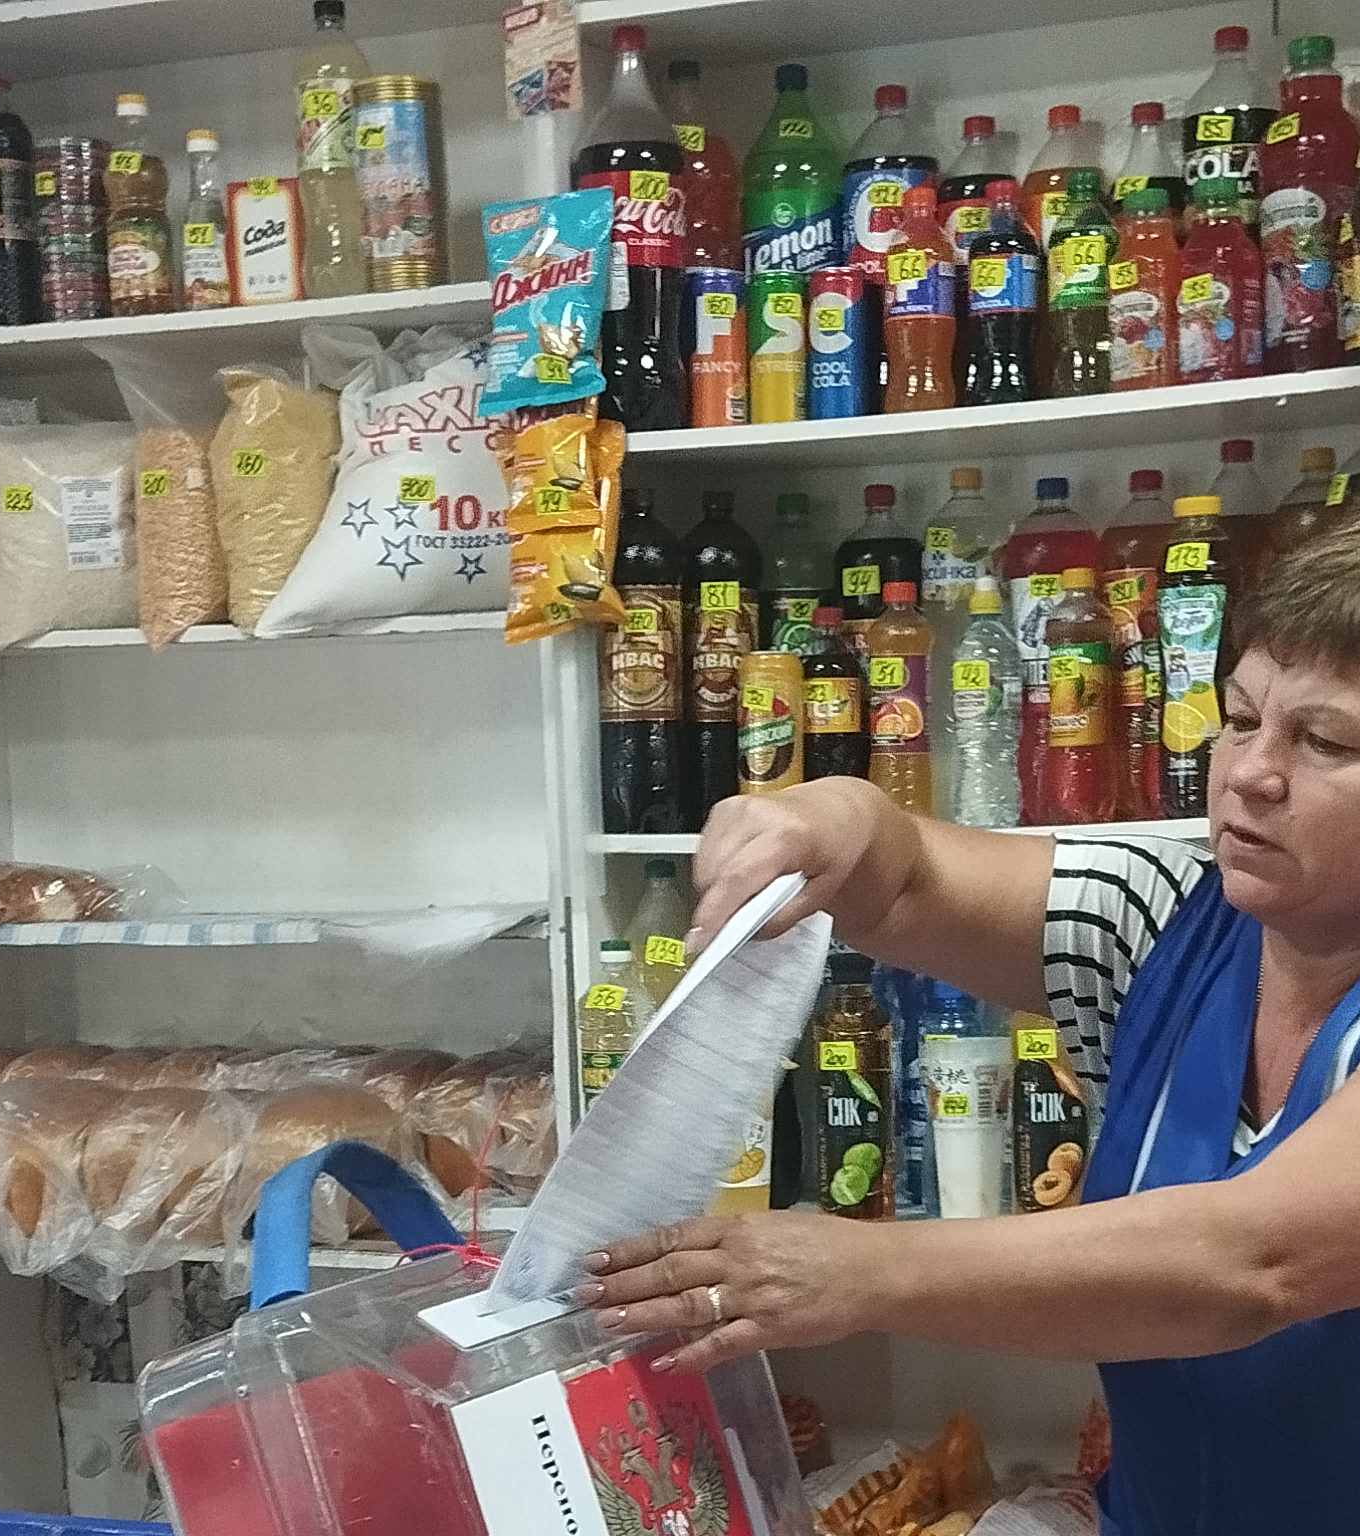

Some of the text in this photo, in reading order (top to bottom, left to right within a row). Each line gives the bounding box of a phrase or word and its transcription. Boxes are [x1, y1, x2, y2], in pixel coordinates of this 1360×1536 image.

[244, 219, 286, 245] Сода
[692, 361, 740, 373] FANCY
[812, 362, 852, 375] COOL
[812, 375, 851, 387] COLA
[429, 494, 481, 531] 10
